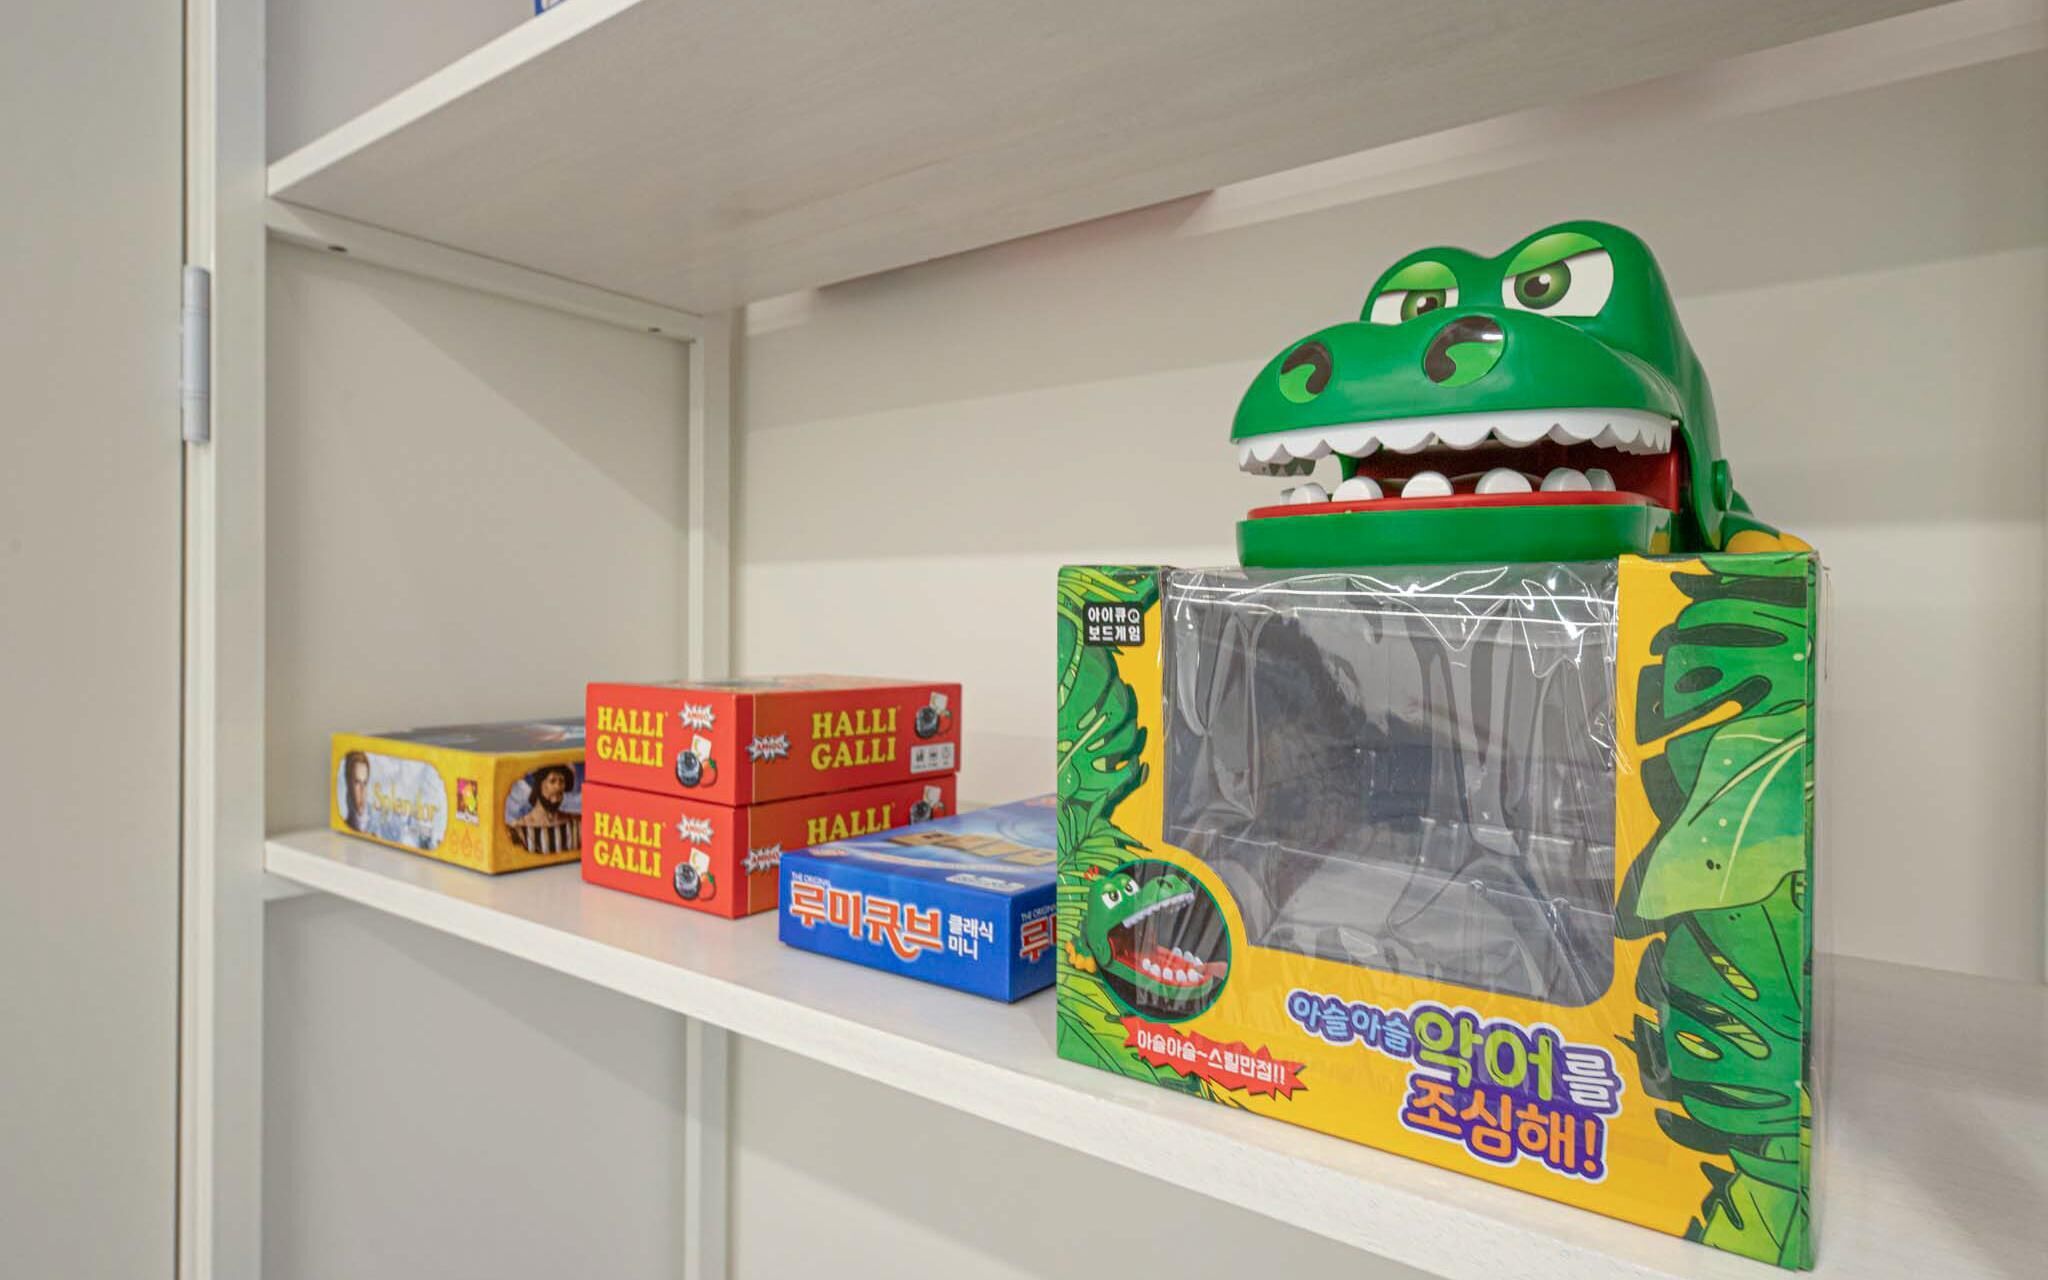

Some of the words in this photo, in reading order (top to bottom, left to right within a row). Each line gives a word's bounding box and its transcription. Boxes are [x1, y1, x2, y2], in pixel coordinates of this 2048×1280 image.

[1088, 625, 1141, 642] 보드게임
[596, 706, 664, 738] HALLI
[812, 707, 897, 740] HALLI
[596, 734, 664, 768] GALLI
[811, 736, 897, 770] GALLI
[593, 811, 662, 848] HALLI
[806, 804, 892, 846] HALLI
[593, 839, 662, 878] GALLI
[790, 880, 943, 962] 루미큐브
[948, 913, 994, 943] 클래식
[1019, 913, 1057, 962] 루
[948, 934, 979, 961] 미니
[1290, 994, 1412, 1055] 아슬아슬
[1412, 1008, 1618, 1110] 악어를
[1405, 1076, 1600, 1174] 조심해!
